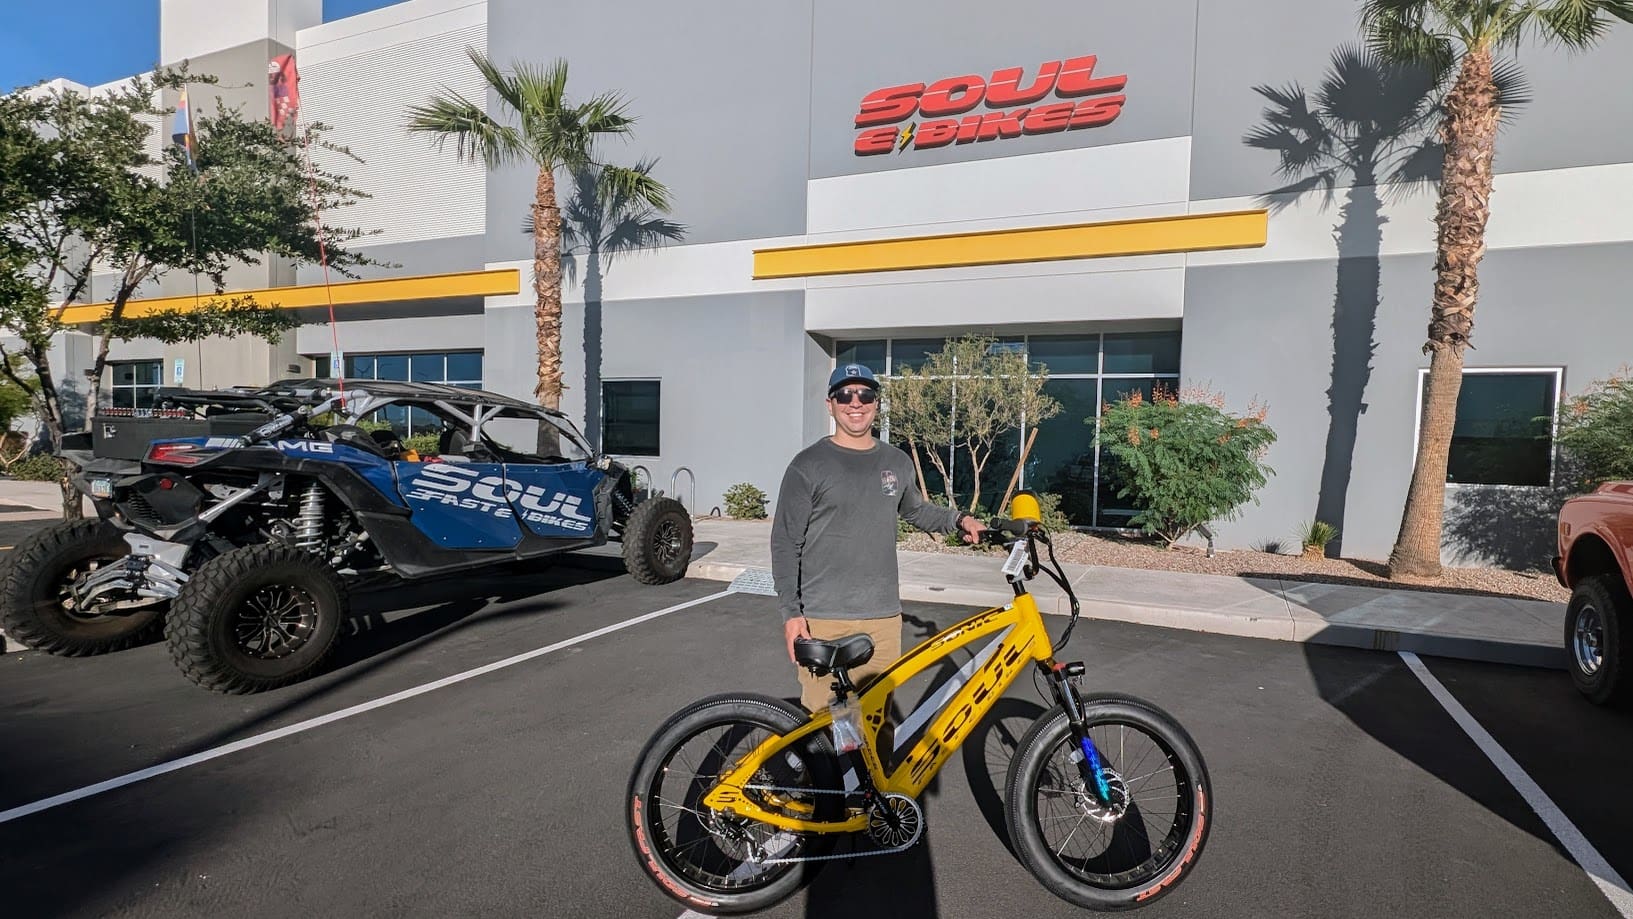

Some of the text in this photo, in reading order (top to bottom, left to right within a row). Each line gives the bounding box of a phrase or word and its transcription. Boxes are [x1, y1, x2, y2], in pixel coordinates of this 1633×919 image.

[855, 55, 1127, 128] SOUL
[914, 95, 1126, 150] BIKES
[412, 463, 592, 521] SOUL
[526, 511, 589, 532] BIKES
[930, 611, 999, 651] SONIC
[910, 634, 1035, 785] SOUL
